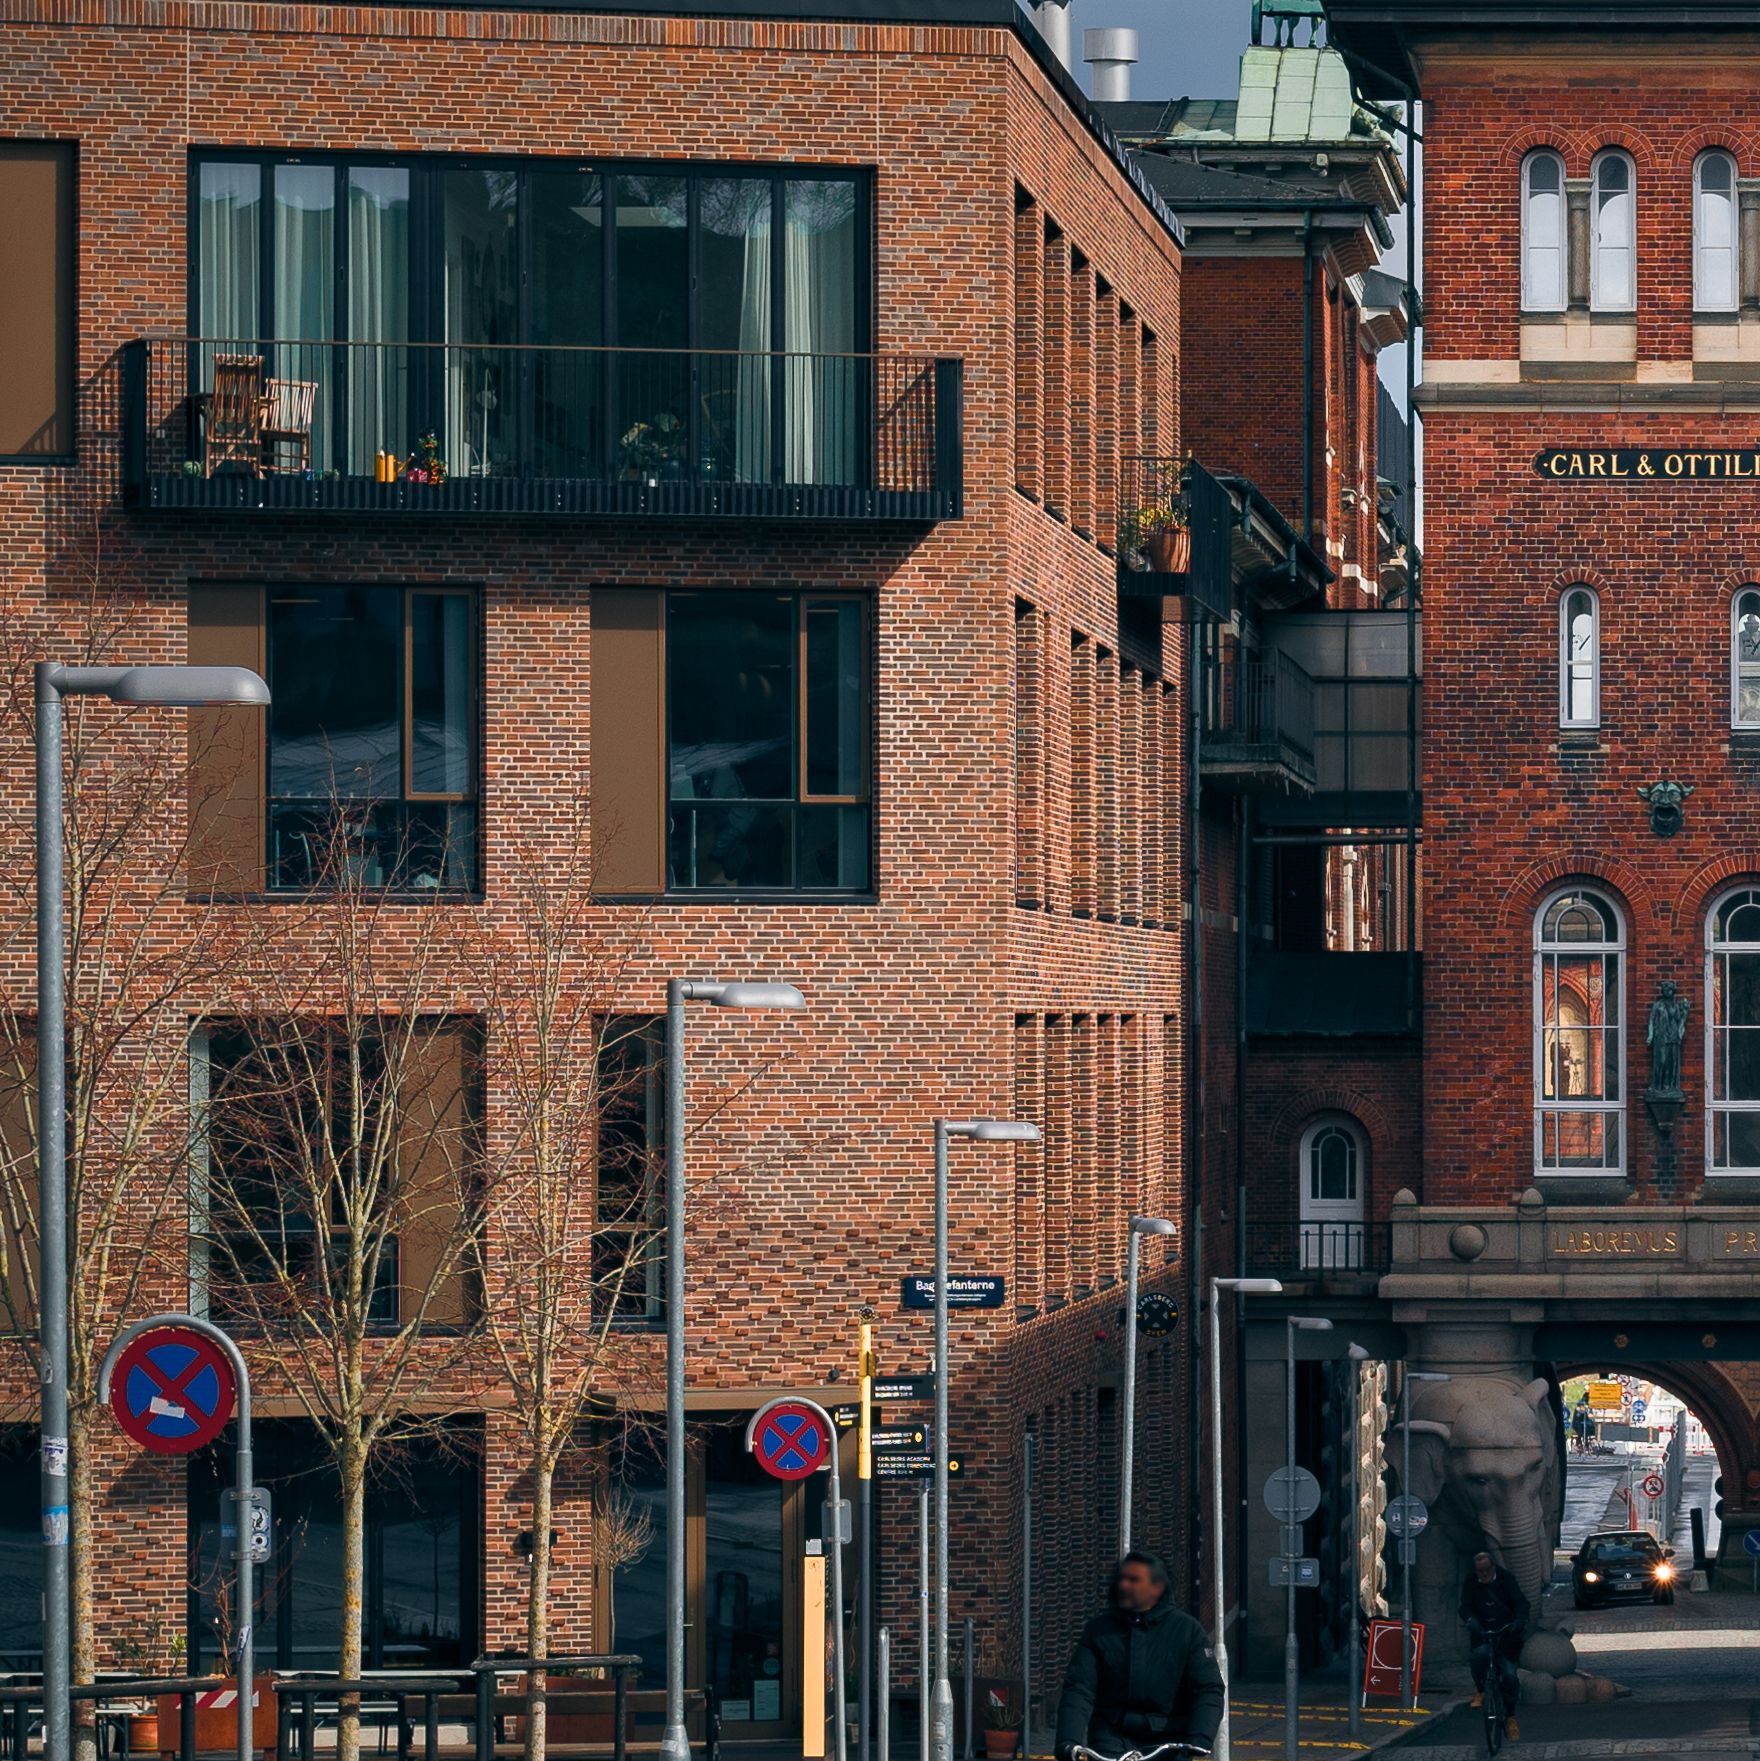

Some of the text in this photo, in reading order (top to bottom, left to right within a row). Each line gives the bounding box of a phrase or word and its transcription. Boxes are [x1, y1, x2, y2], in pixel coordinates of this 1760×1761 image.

[1550, 454, 1629, 476] CARL
[1637, 454, 1655, 476] &
[1554, 1230, 1679, 1253] LABOREMUS
[946, 1280, 995, 1290] efanterne
